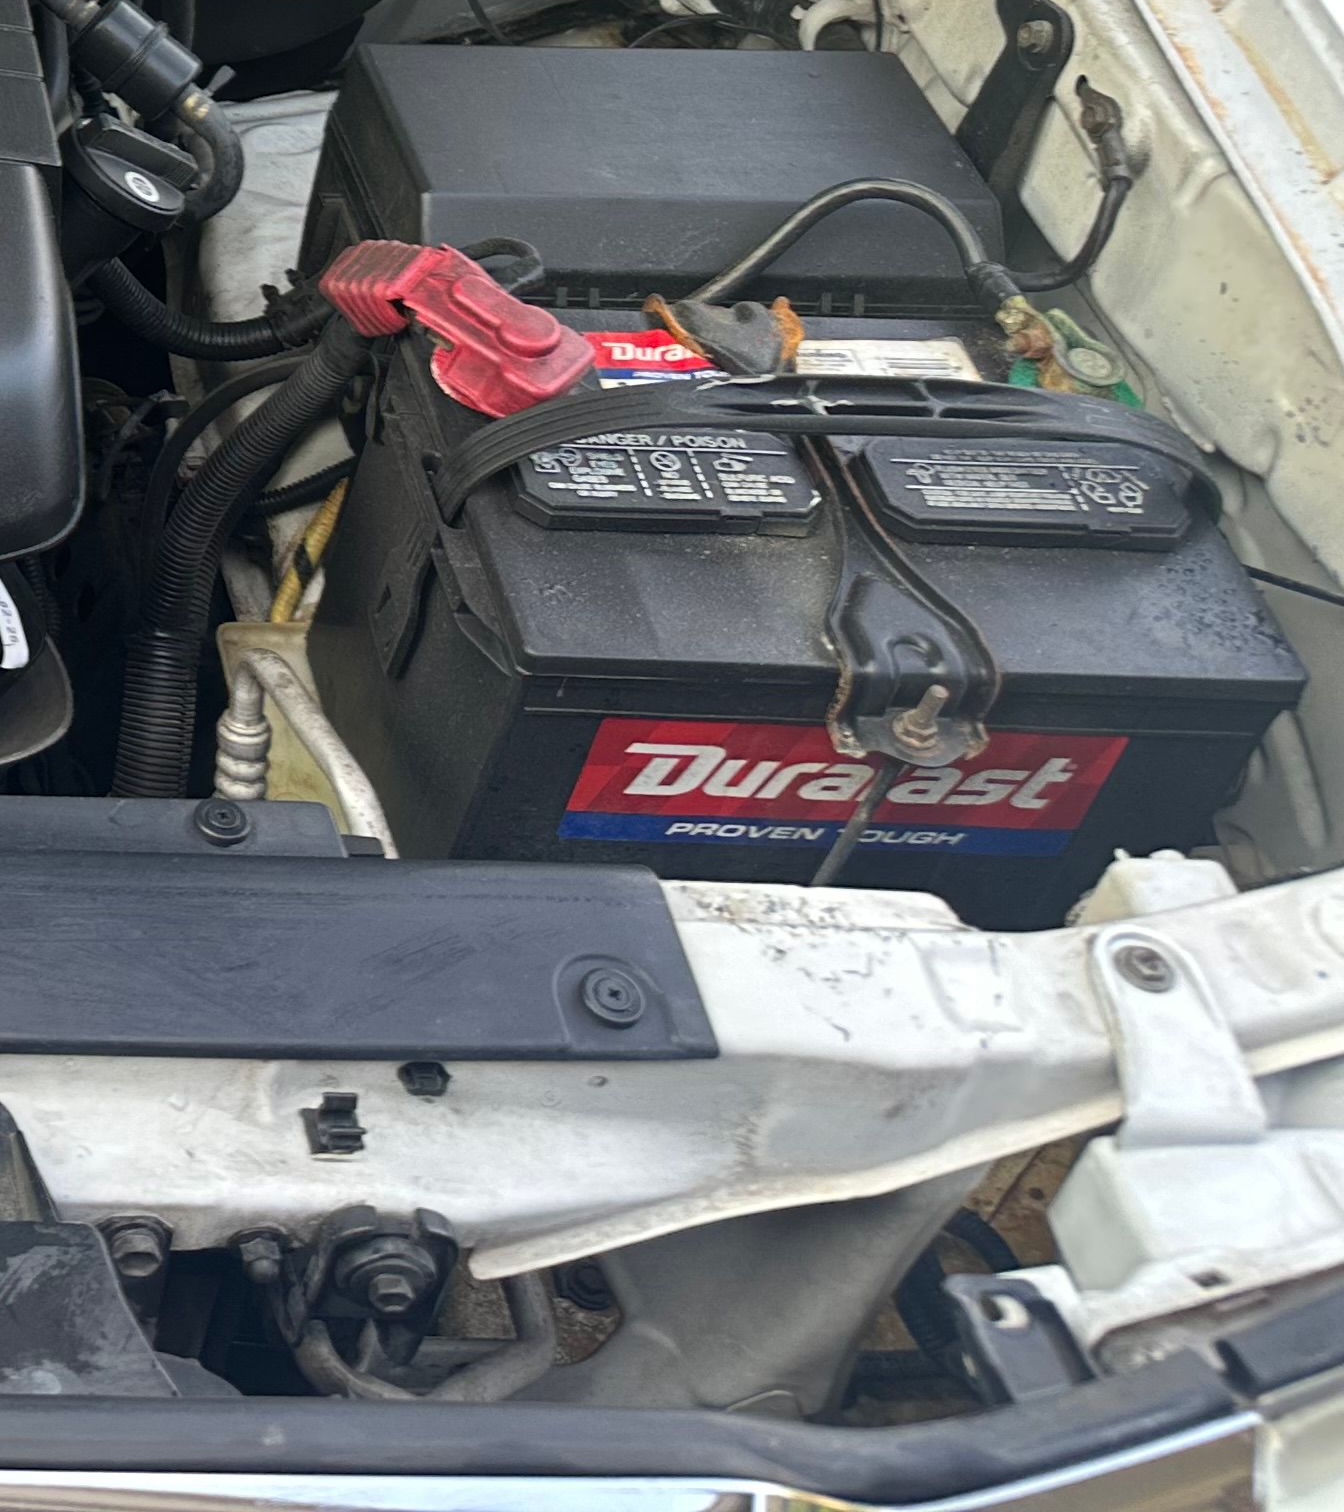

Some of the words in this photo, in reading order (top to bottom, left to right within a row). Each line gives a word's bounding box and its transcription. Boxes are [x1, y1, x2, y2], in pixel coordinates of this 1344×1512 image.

[601, 341, 700, 362] Dura
[670, 435, 748, 448] POISON
[623, 742, 1078, 809] Duraast
[664, 821, 825, 840] PROVEN
[837, 828, 967, 846] OUGH
